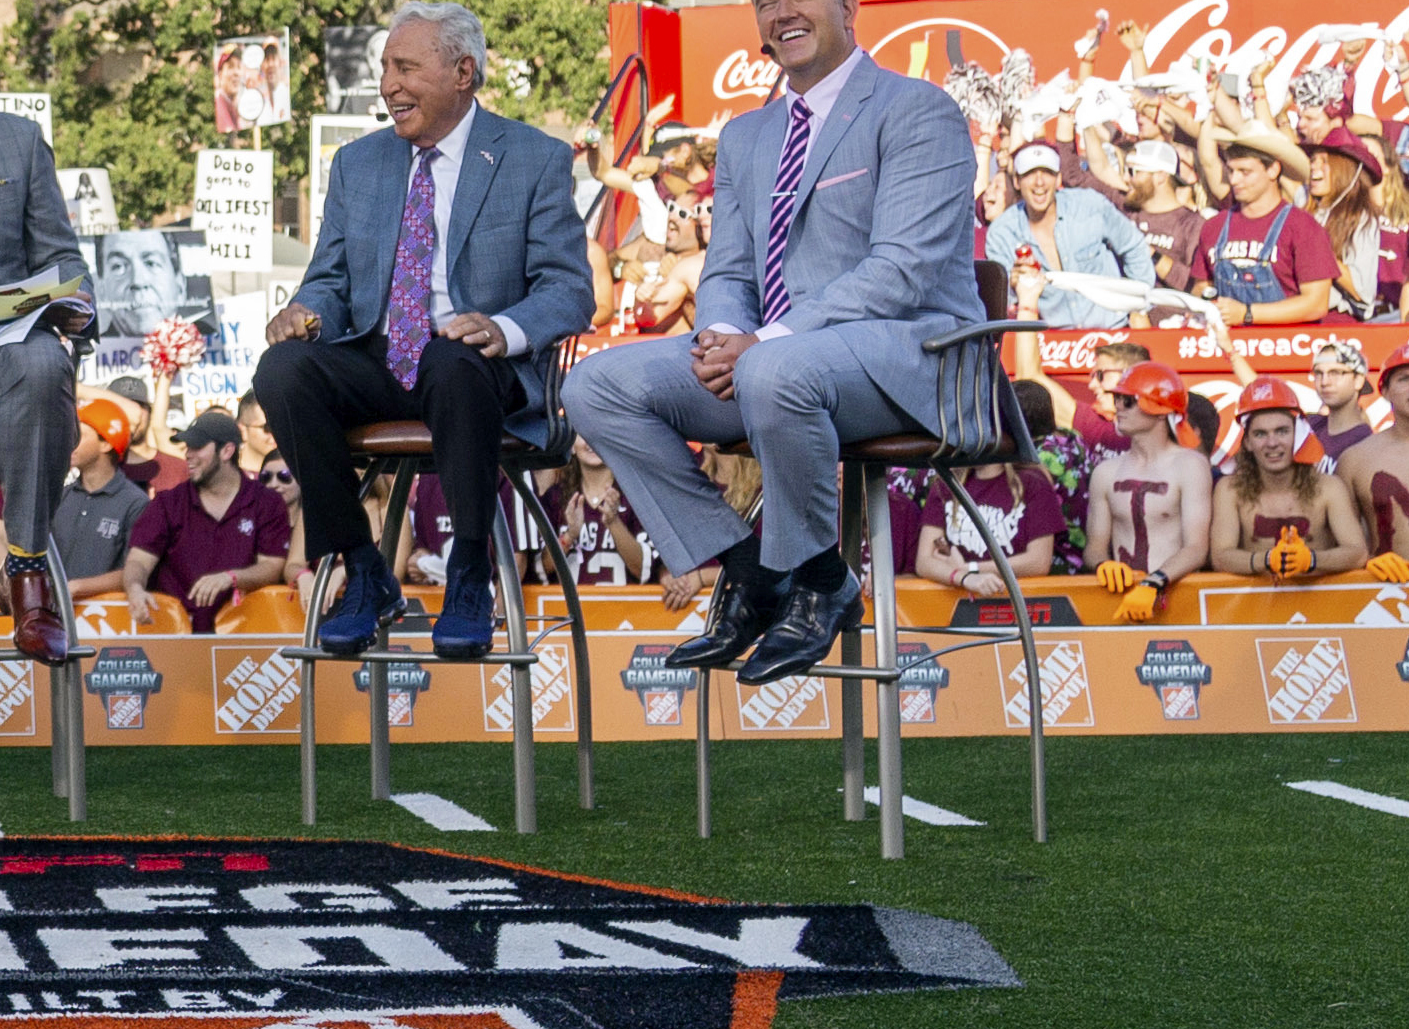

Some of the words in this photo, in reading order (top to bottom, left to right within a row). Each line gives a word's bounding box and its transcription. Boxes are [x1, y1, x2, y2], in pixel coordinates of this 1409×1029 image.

[214, 154, 254, 173] Dabo
[206, 176, 233, 190] goes
[237, 177, 251, 189] to
[208, 220, 224, 232] for
[231, 222, 256, 235] the
[79, 345, 142, 382] JIMBO
[186, 372, 238, 396] SIGN
[98, 660, 148, 671] COLLEGE
[1146, 652, 1195, 663] COLLEGE
[1270, 647, 1305, 679] THE
[91, 673, 158, 688] GAMEDAY
[223, 656, 260, 689] THE
[626, 670, 692, 685] GAMEDAY
[1141, 665, 1207, 679] GAMEDAY
[1268, 637, 1344, 722] HOME
[251, 676, 301, 731] DEPOT
[776, 673, 824, 728] DEPOT
[1301, 668, 1349, 722] DEPOT
[157, 987, 289, 1012] BY
